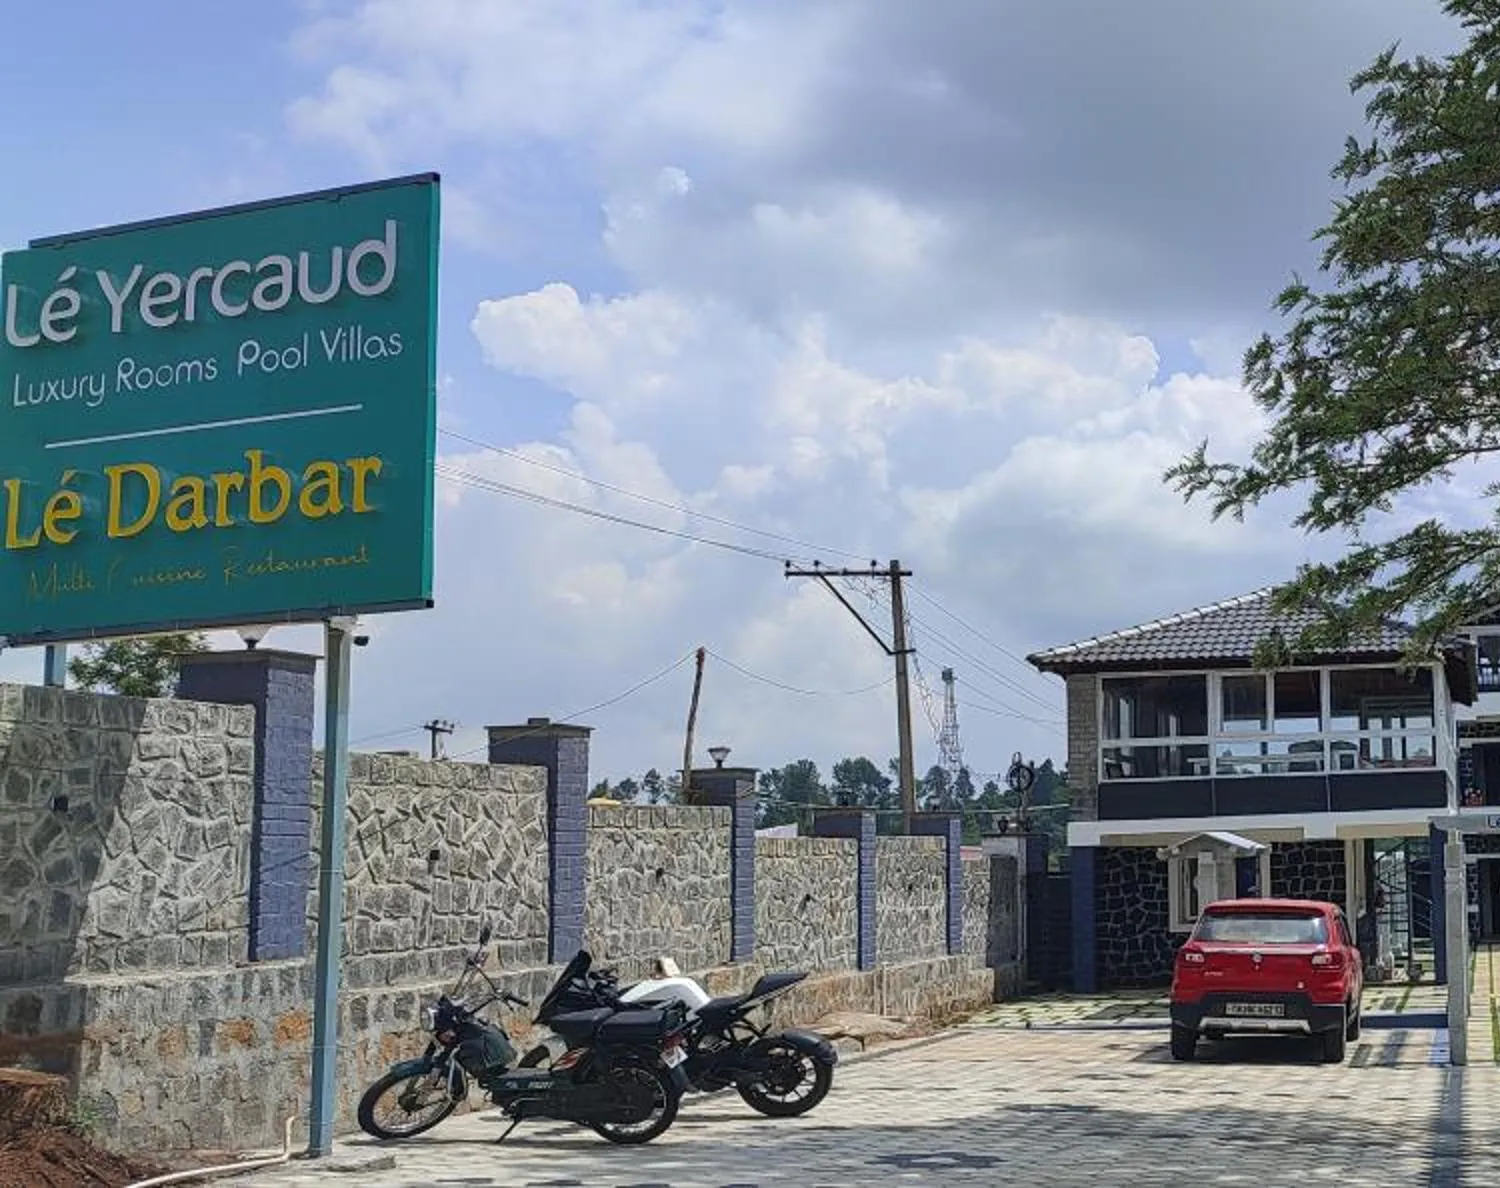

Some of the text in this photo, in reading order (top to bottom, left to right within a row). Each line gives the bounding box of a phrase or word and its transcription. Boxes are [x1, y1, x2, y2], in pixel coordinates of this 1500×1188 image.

[5, 219, 398, 348] Lé Yercaud
[13, 324, 403, 408] Luxury Rooms Pool Villas
[4, 448, 383, 551] Lé Darbar
[28, 561, 96, 603] Multi
[223, 545, 371, 585] Restaurant
